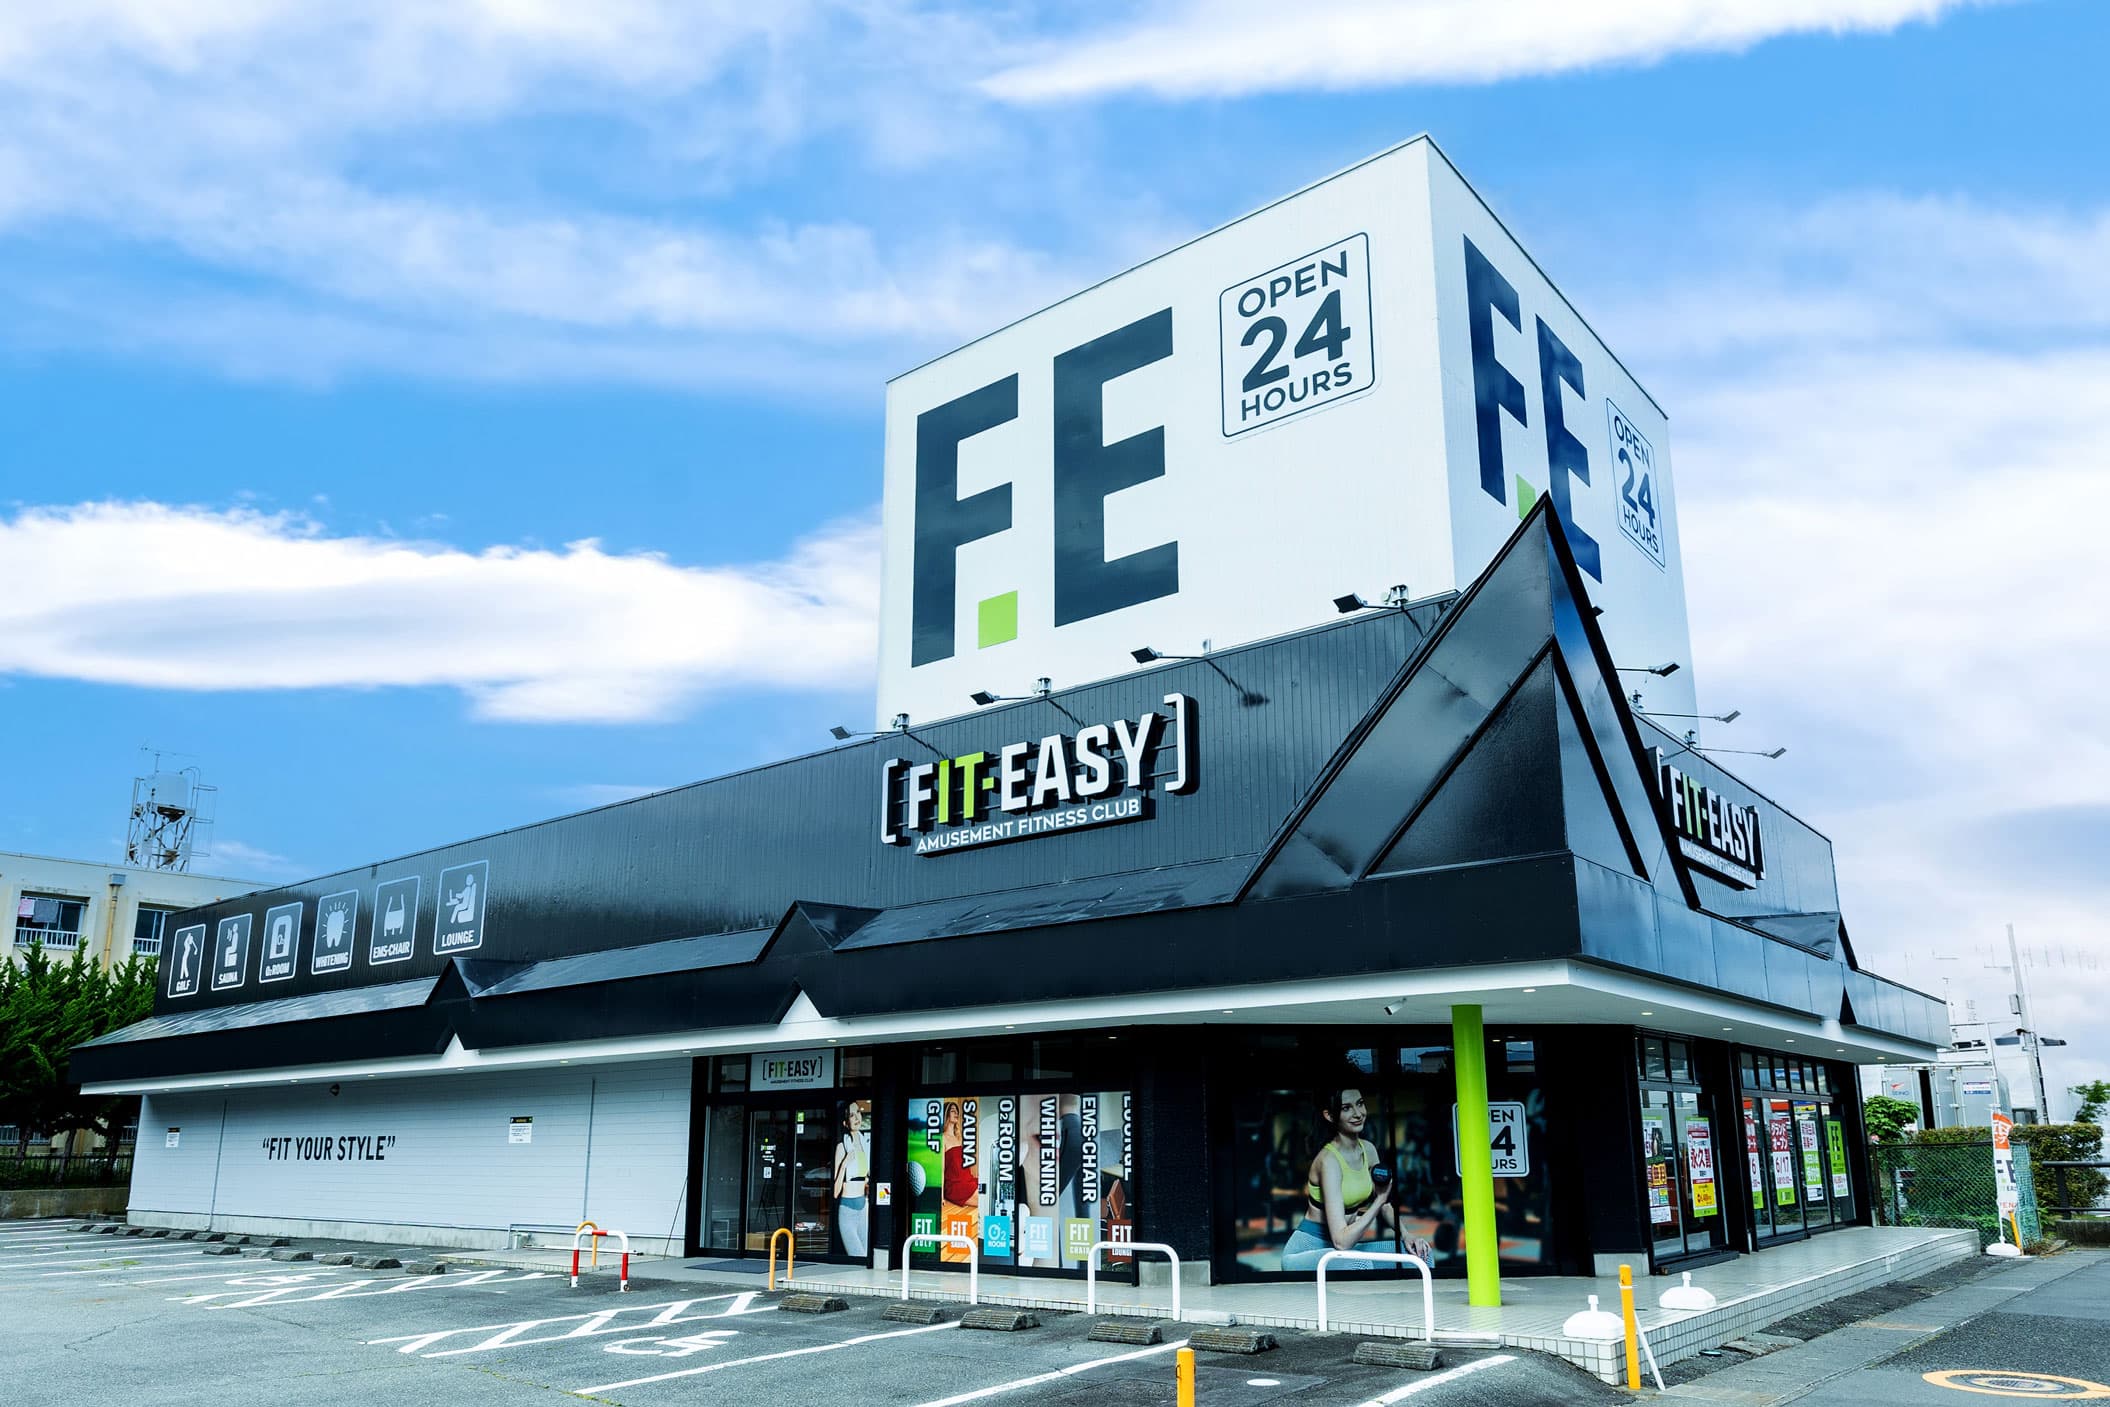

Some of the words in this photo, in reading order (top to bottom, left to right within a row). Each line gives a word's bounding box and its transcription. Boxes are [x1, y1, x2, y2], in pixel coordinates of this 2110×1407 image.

[1238, 251, 1348, 317] OPEN
[1241, 289, 1351, 394] 24
[1241, 361, 1353, 422] HOURS
[1613, 414, 1650, 471] OPEN
[1618, 447, 1656, 530] 24
[1623, 505, 1659, 553] HOURS
[916, 822, 1013, 852] AMUSEMENT
[1018, 808, 1087, 834] FITNESS
[1092, 798, 1140, 820] CLUB
[441, 930, 475, 948] LOUNGE
[315, 952, 350, 969] WHITENING
[175, 979, 192, 993] GOLF
[218, 971, 239, 985] SAUNA
[1488, 1109, 1515, 1122] EN
[927, 1101, 940, 1153] GOLF
[962, 1101, 976, 1168] SAUNA
[296, 1137, 333, 1161] YOUR
[1490, 1125, 1516, 1156] 4
[1040, 1097, 1056, 1207] WHITENING
[1491, 1158, 1518, 1170] URS
[915, 1218, 932, 1235] FIT
[951, 1221, 968, 1237] FIT
[1030, 1223, 1048, 1239] FIT
[1069, 1223, 1089, 1241] FIT
[1112, 1225, 1132, 1243] FIT
[988, 1240, 1006, 1248] ROOM
